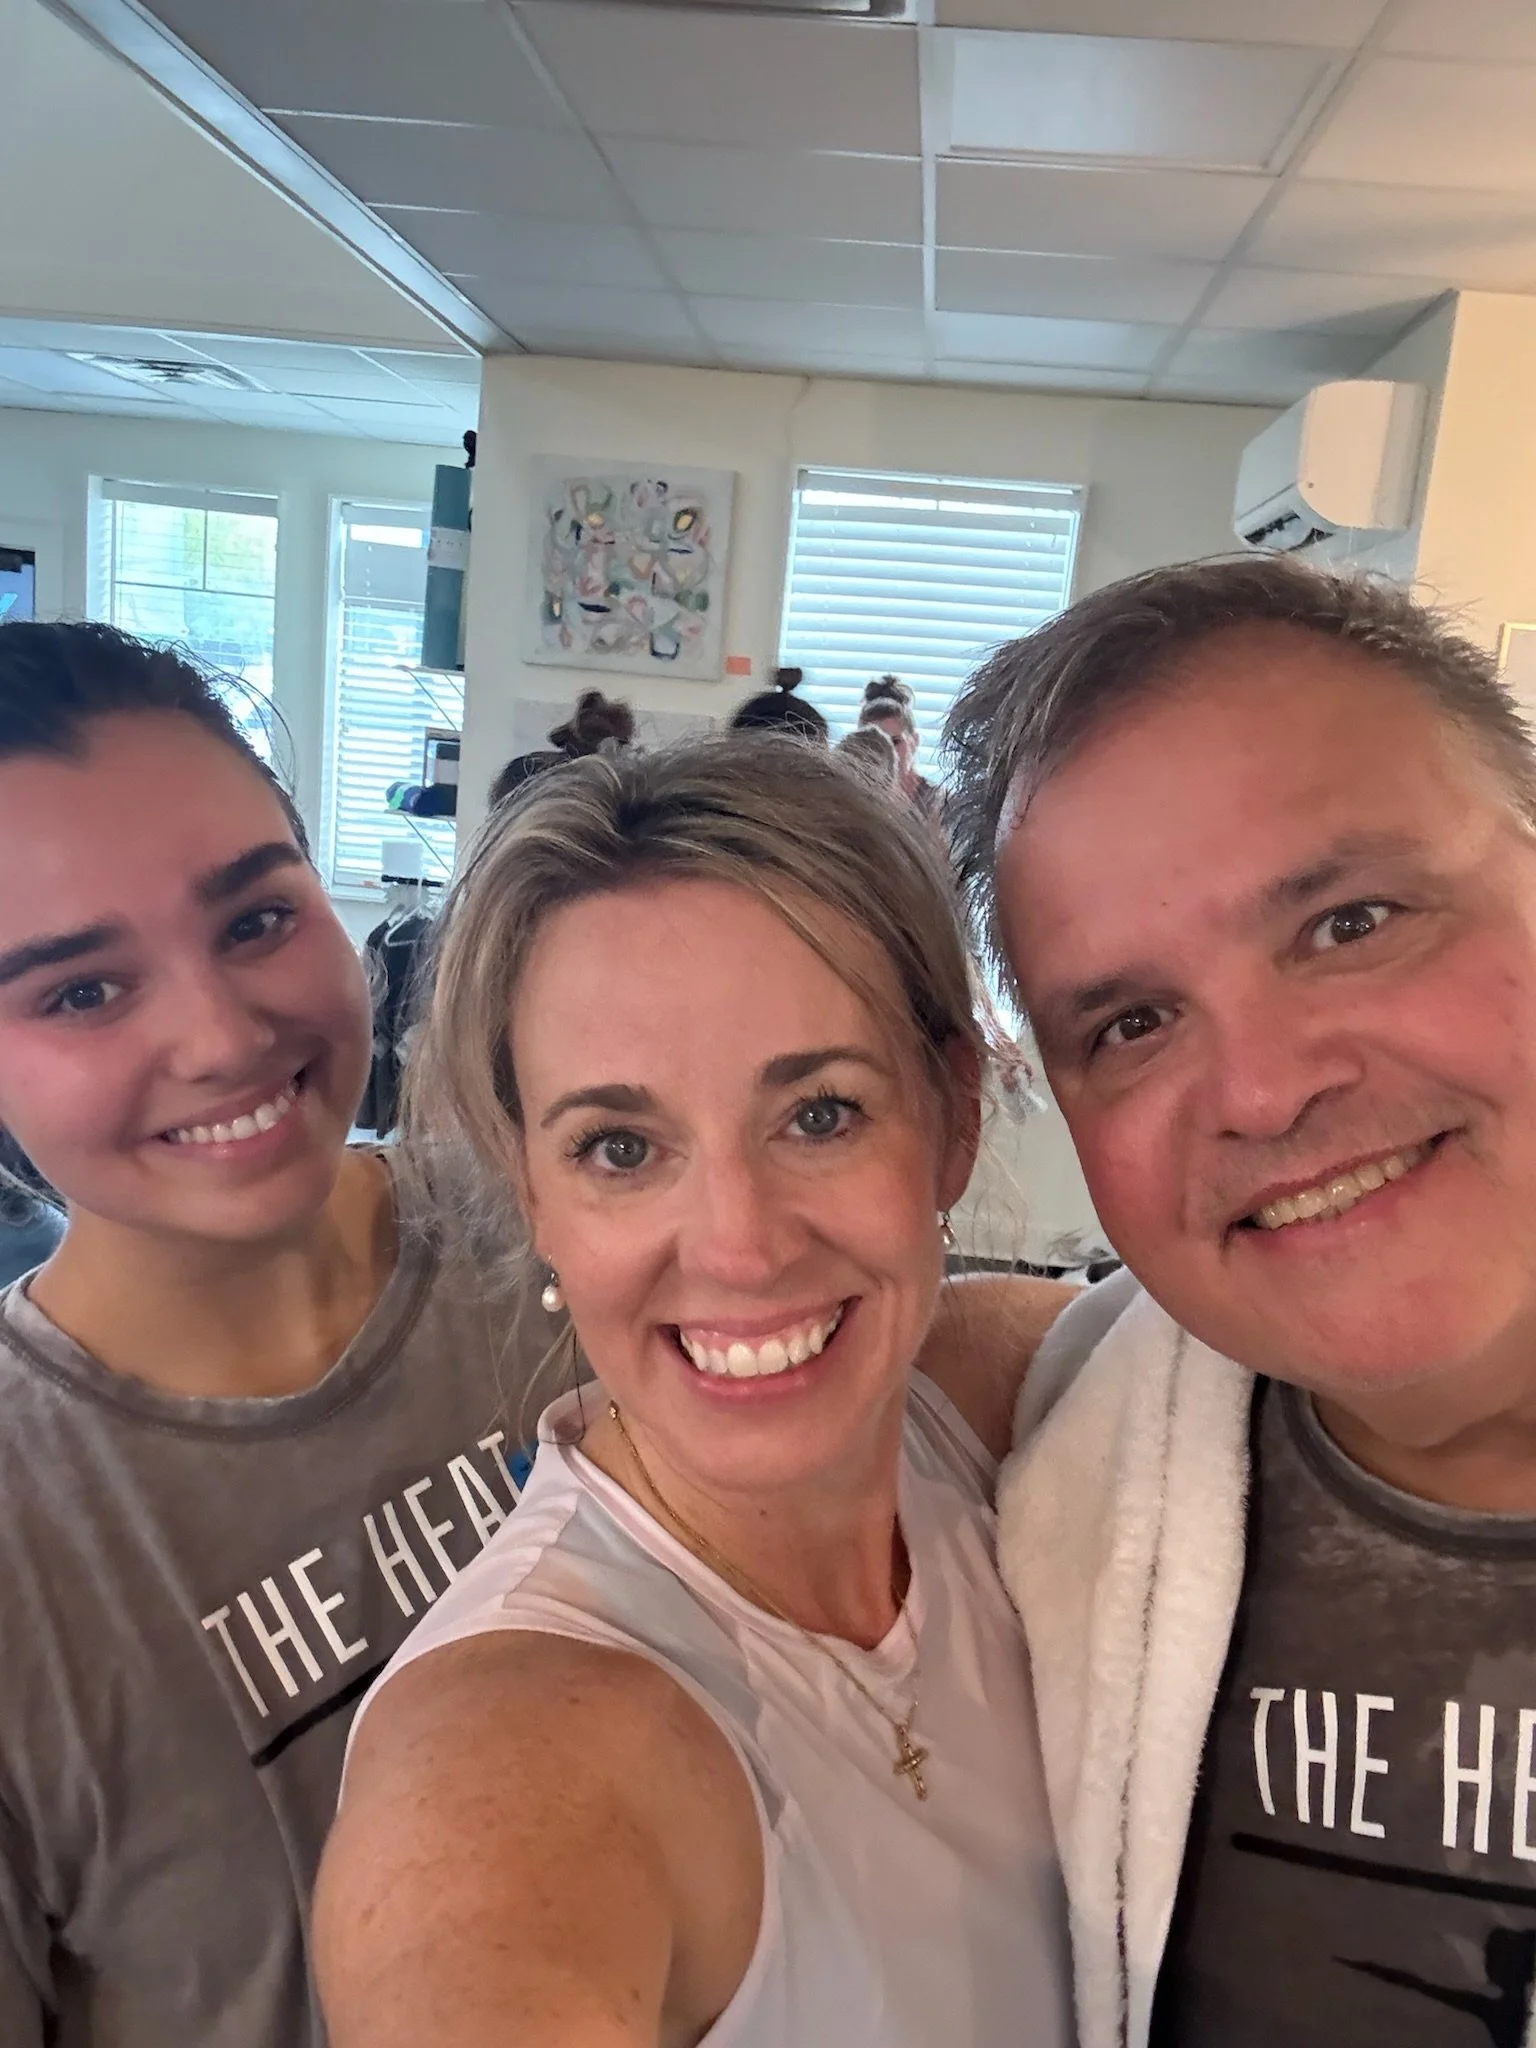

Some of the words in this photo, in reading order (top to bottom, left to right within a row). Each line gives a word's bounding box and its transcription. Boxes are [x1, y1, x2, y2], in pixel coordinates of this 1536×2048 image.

[201, 1547, 369, 1718] THE
[363, 1430, 523, 1618] HEAT
[1250, 1687, 1394, 1839] THE
